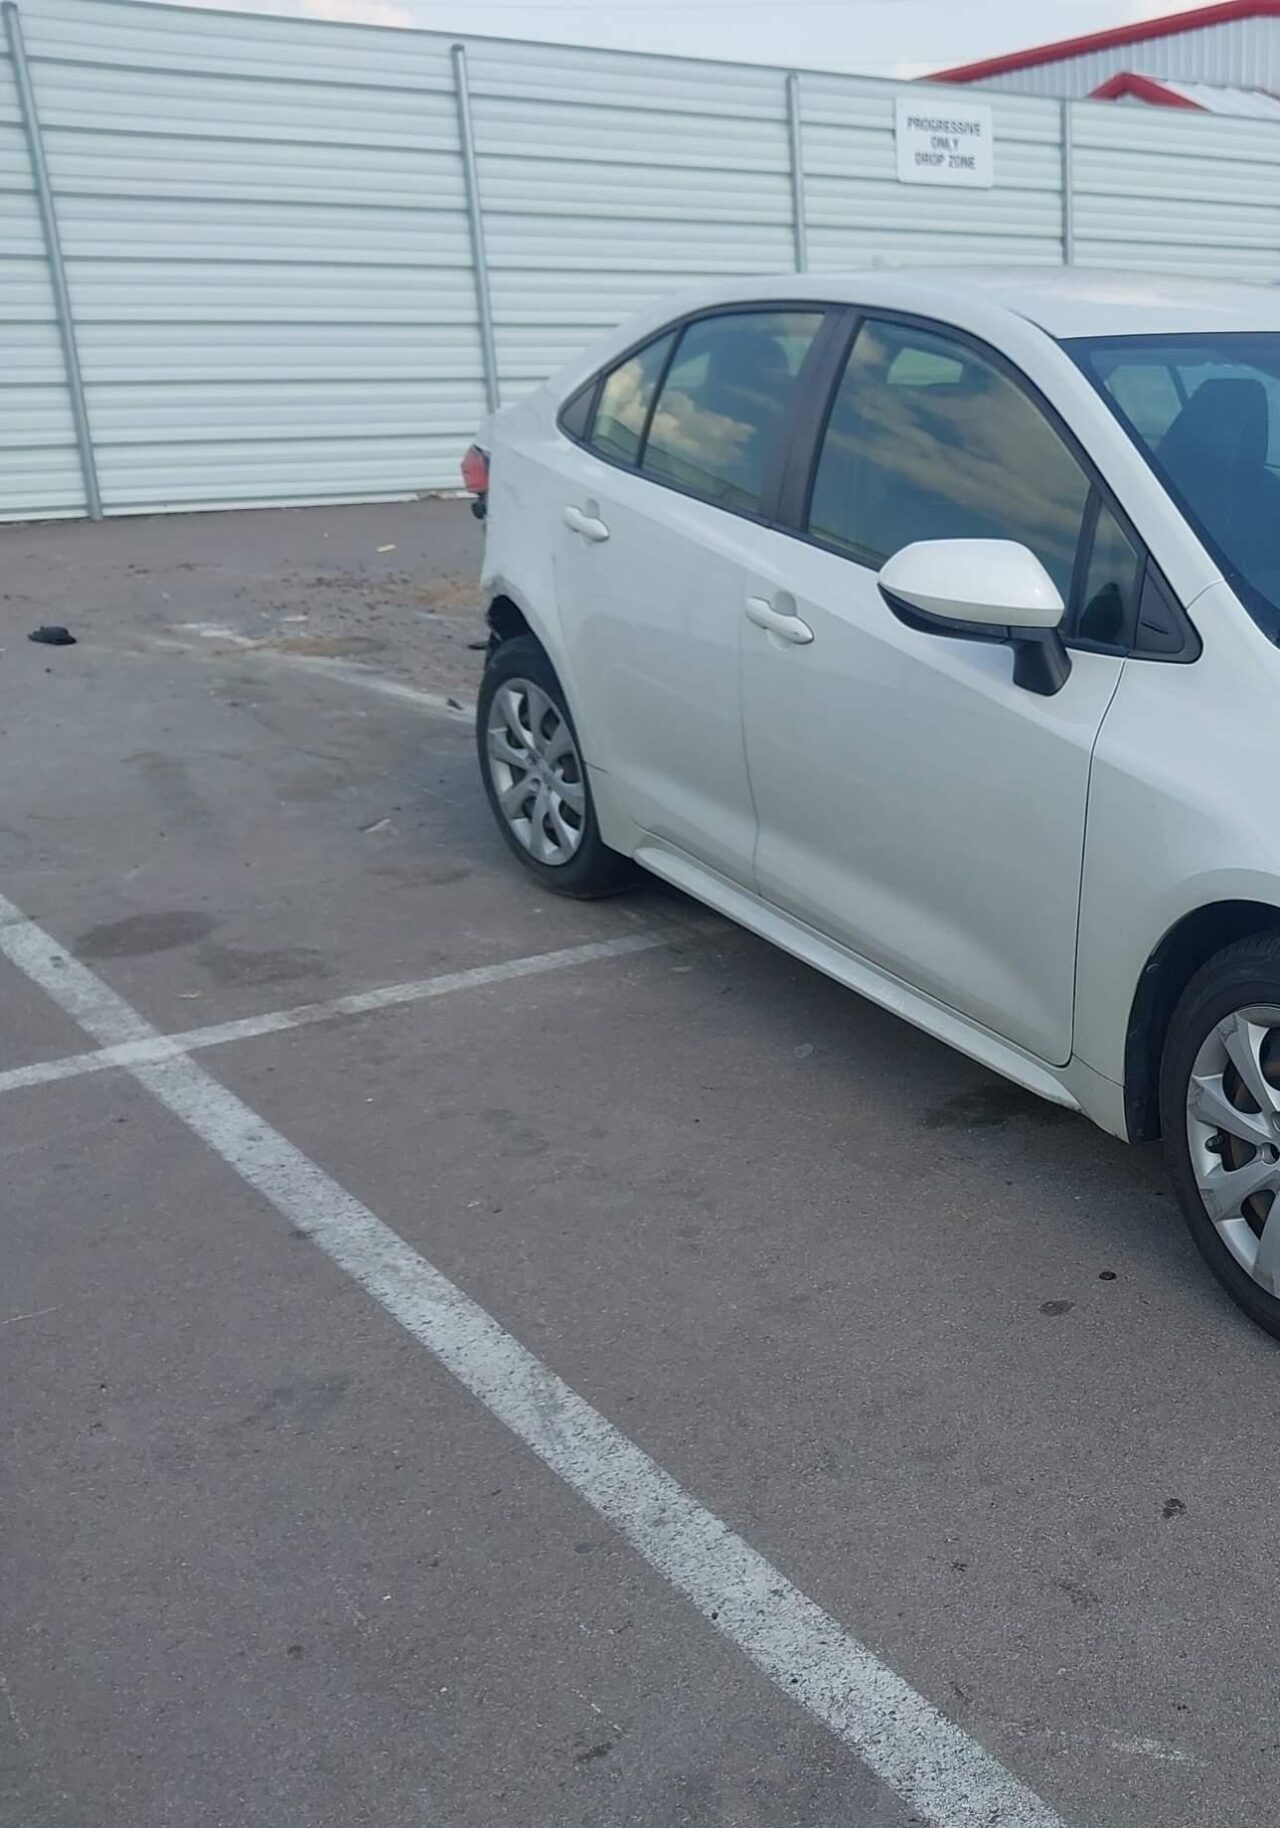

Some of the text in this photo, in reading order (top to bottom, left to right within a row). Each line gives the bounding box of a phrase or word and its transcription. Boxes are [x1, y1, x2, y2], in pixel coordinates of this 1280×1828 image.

[907, 117, 981, 137] PROGRESSIVE
[930, 136, 959, 151] ONLY
[914, 152, 976, 170] DROP ZONE
